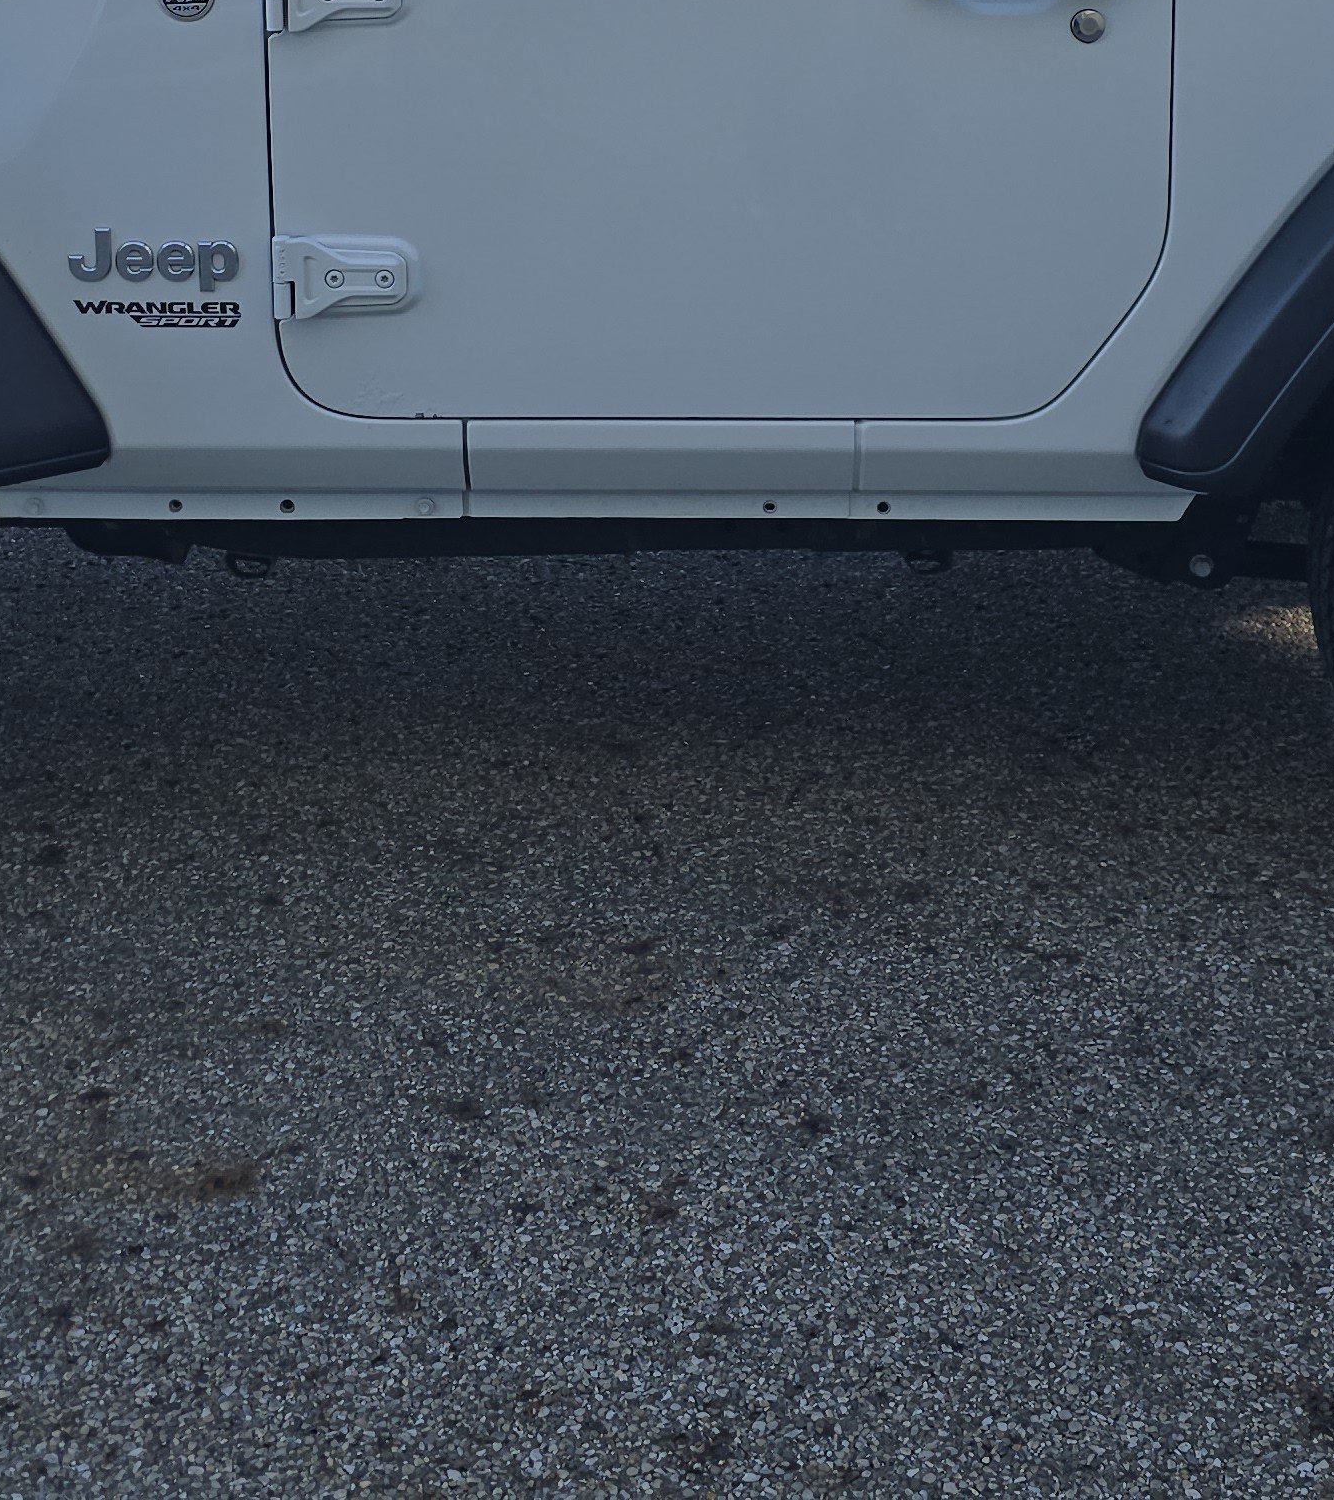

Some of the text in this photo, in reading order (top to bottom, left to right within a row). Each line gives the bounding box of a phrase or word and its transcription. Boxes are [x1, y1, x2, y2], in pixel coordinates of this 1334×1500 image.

[67, 226, 240, 293] Jeep
[72, 299, 241, 315] WRANGLER
[139, 316, 240, 327] SPORT
